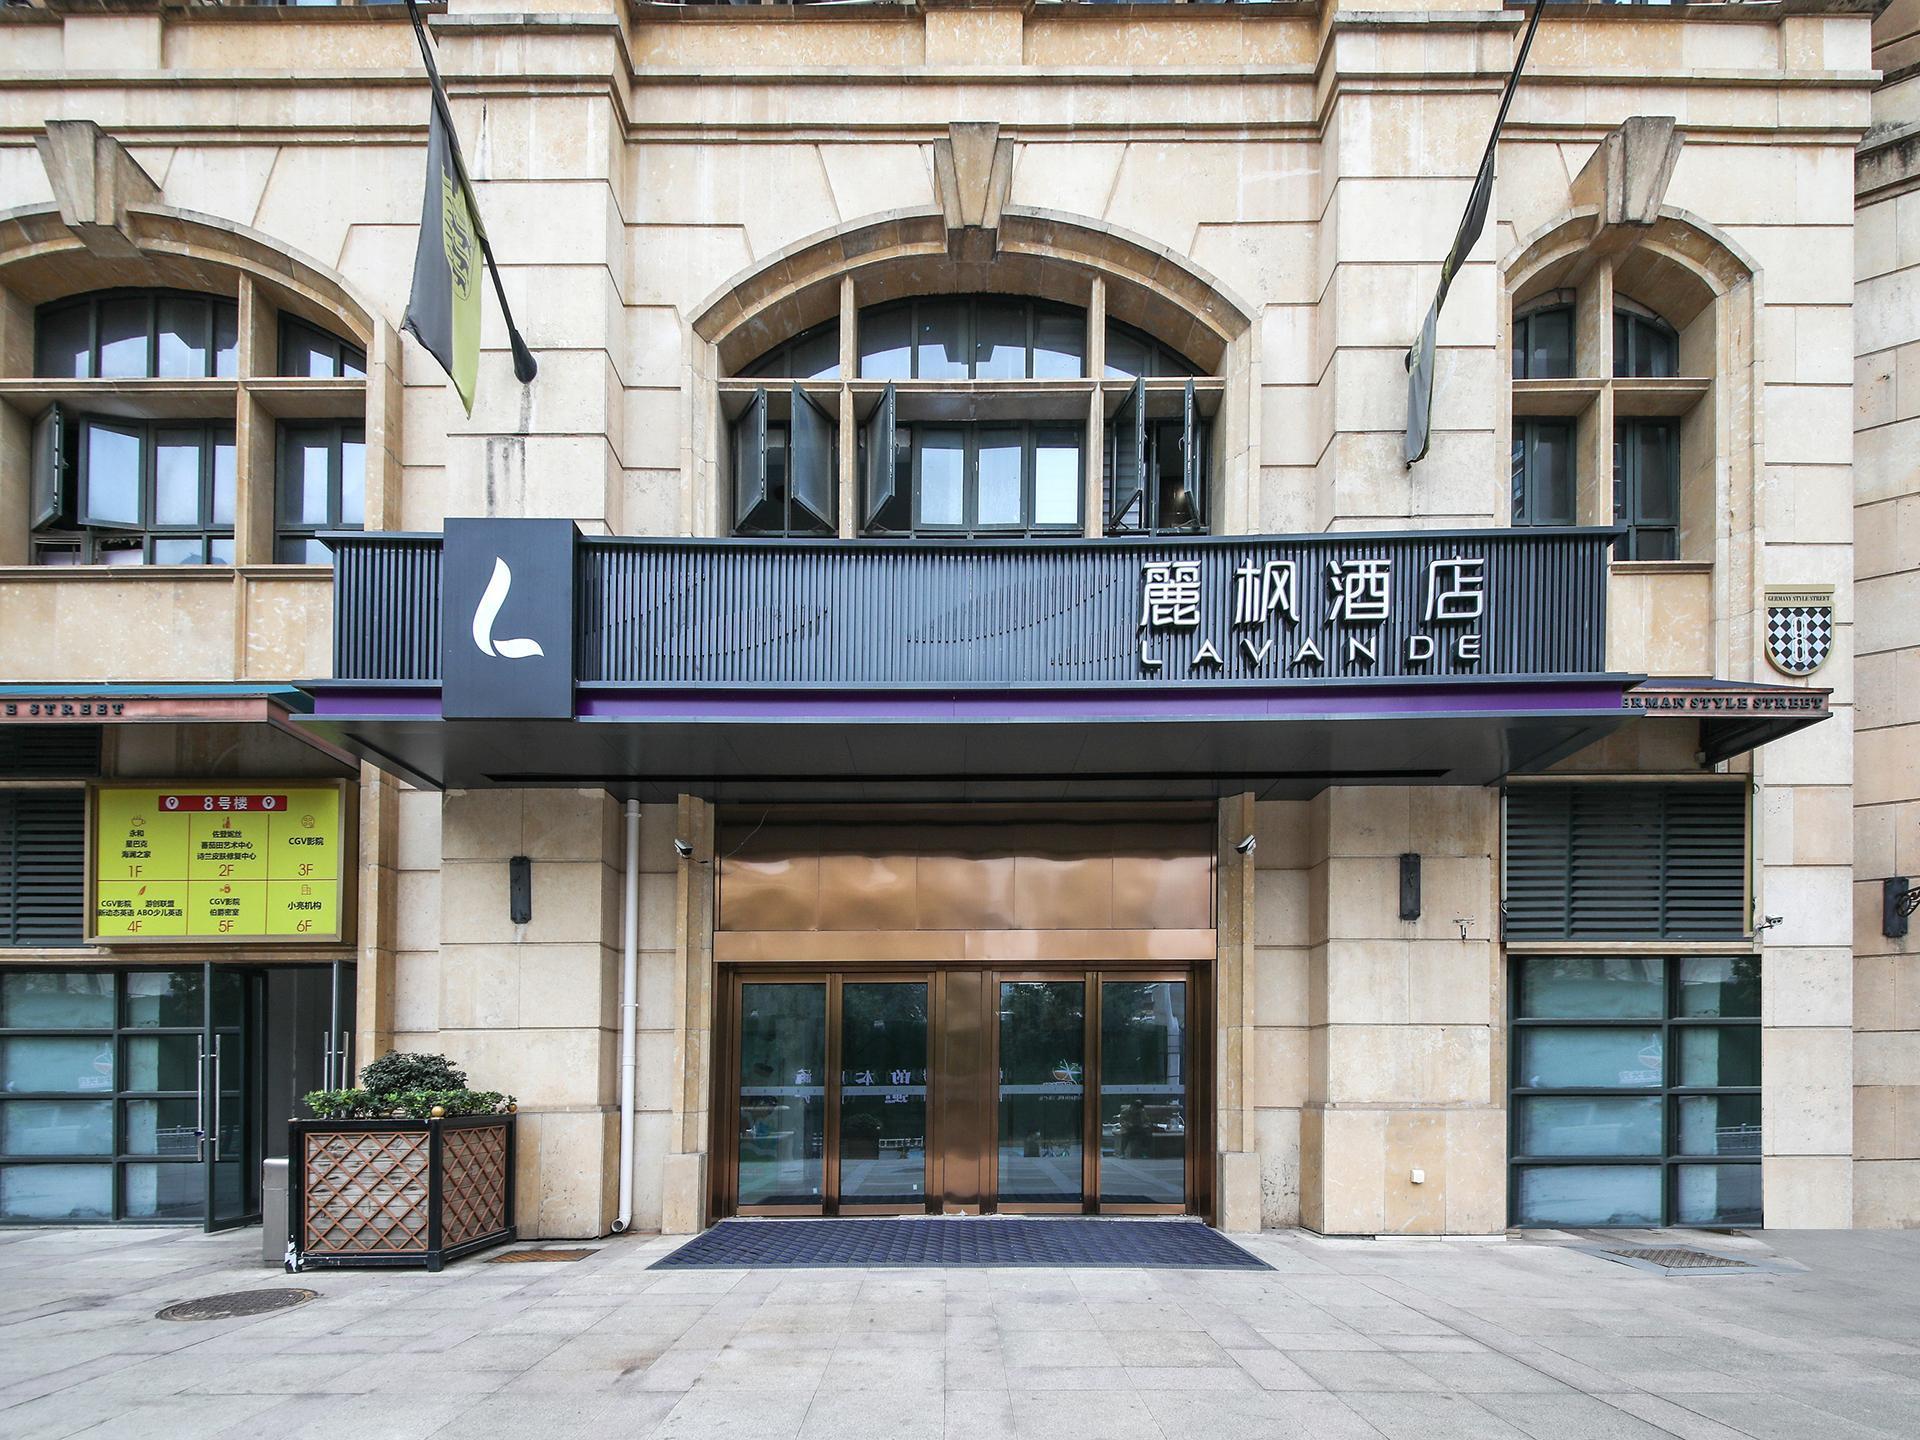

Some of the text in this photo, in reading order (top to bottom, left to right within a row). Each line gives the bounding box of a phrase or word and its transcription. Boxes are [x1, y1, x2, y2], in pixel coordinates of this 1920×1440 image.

[1140, 633, 1483, 667] LAVANDE
[30, 703, 125, 715] STREET
[1690, 696, 1748, 710] STYLE
[1752, 696, 1823, 710] STREET
[203, 796, 248, 811] 8号楼
[288, 837, 325, 846] CGV影院
[128, 865, 143, 878] 1F
[218, 864, 235, 877] 2F
[298, 863, 314, 876] 3F
[209, 898, 241, 906] CGV影院
[127, 920, 143, 933] 4F
[218, 920, 234, 933] 5F
[296, 919, 313, 933] 6F
